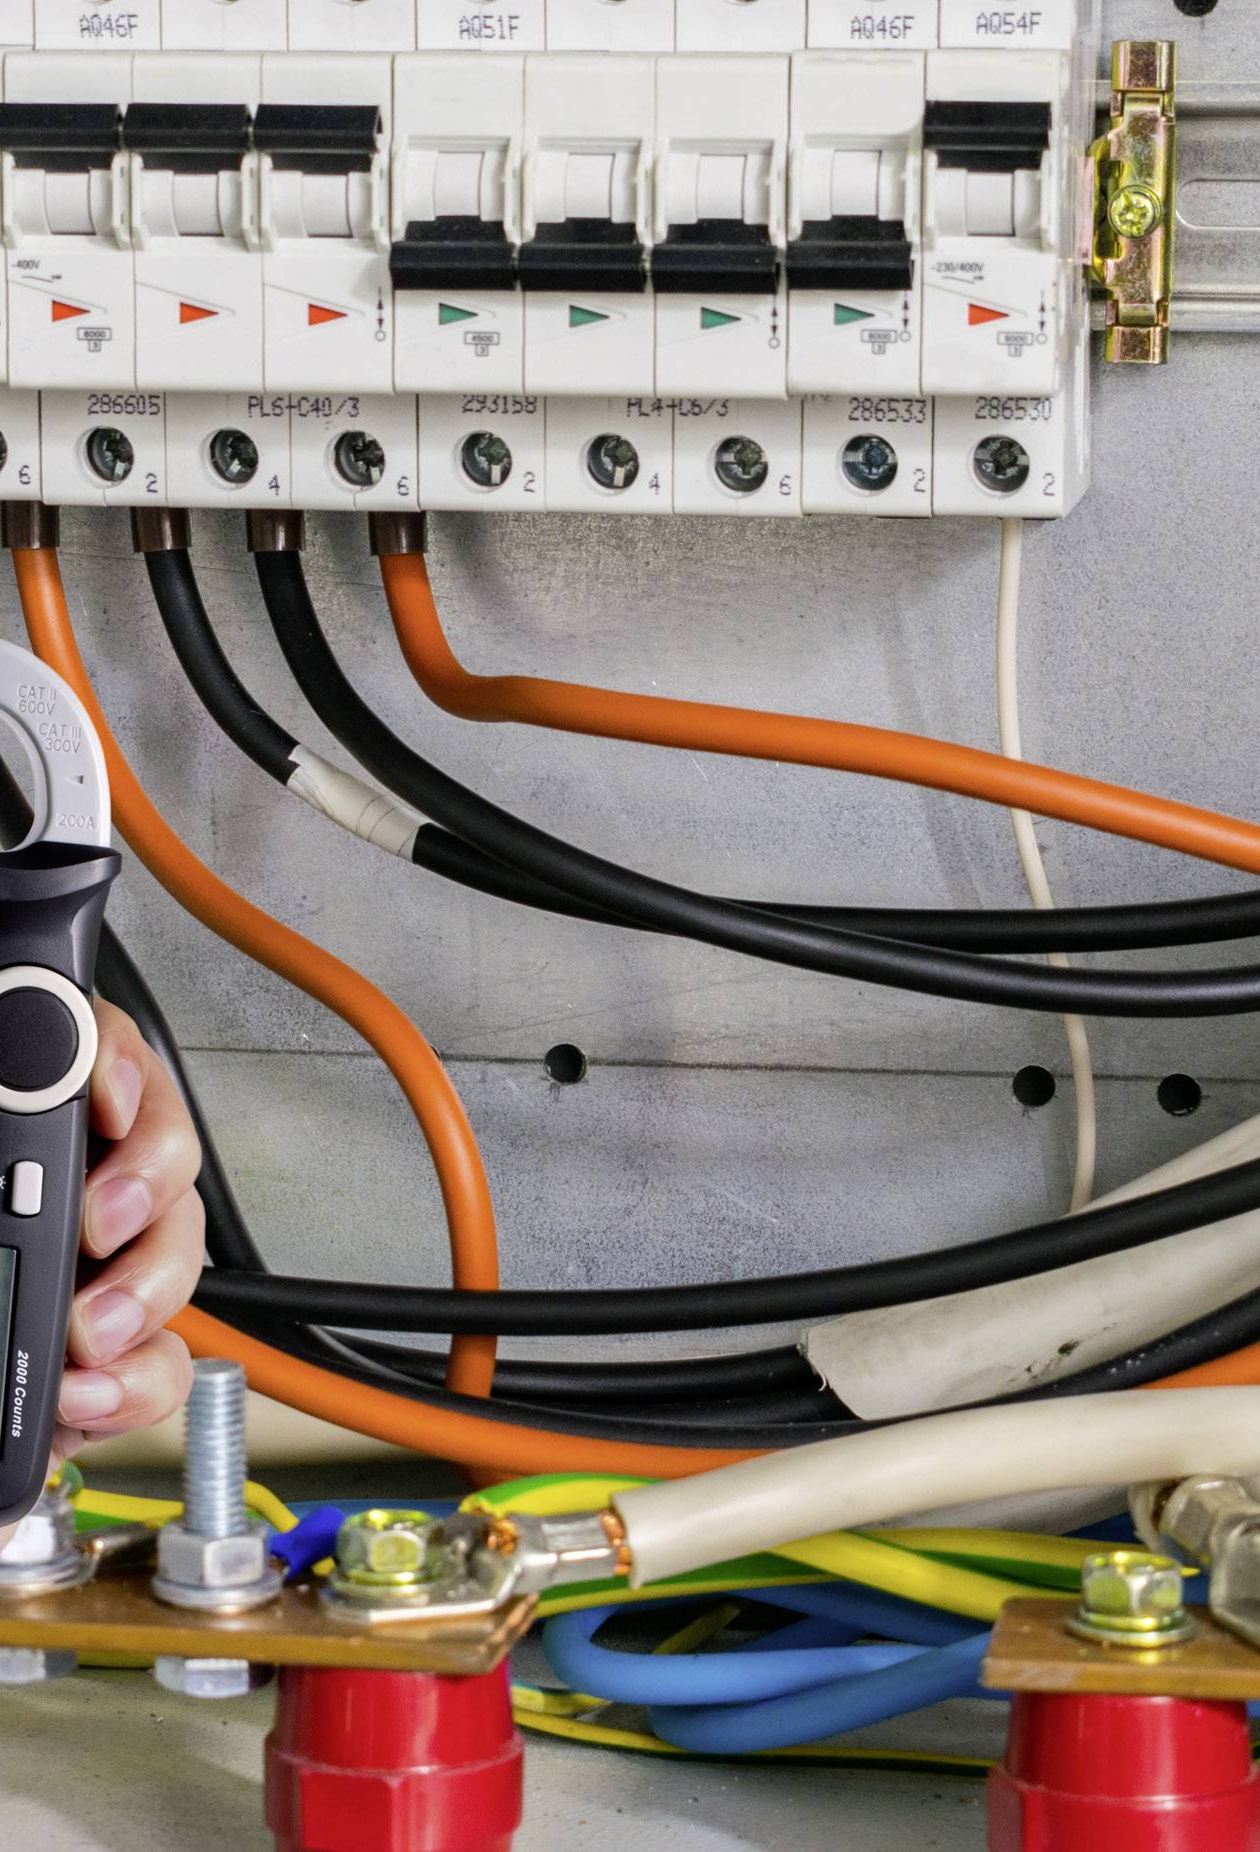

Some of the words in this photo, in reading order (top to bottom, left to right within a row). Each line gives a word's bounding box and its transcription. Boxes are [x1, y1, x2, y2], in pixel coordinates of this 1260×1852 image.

[80, 14, 138, 38] AQ46F
[459, 15, 519, 40] AQ51F
[850, 16, 915, 39] AQ46F
[976, 12, 1042, 36] AQ54F
[88, 394, 161, 415] 286605
[848, 397, 926, 423] 286533
[975, 396, 1052, 420] 286530
[19, 465, 31, 485] 6
[146, 473, 158, 493] 2
[268, 475, 280, 495] 4
[524, 472, 535, 492] 2
[649, 473, 660, 495] 4
[779, 475, 791, 495] 6
[914, 468, 925, 493] 2
[1043, 473, 1055, 496] 2
[397, 476, 409, 496] 6
[18, 685, 45, 699] CAT
[19, 700, 55, 715] 600V
[39, 722, 67, 737] CAT
[44, 738, 81, 753] 300V
[58, 813, 95, 829] 200A
[15, 1350, 29, 1385] 2000
[12, 1387, 26, 1438] Counts
